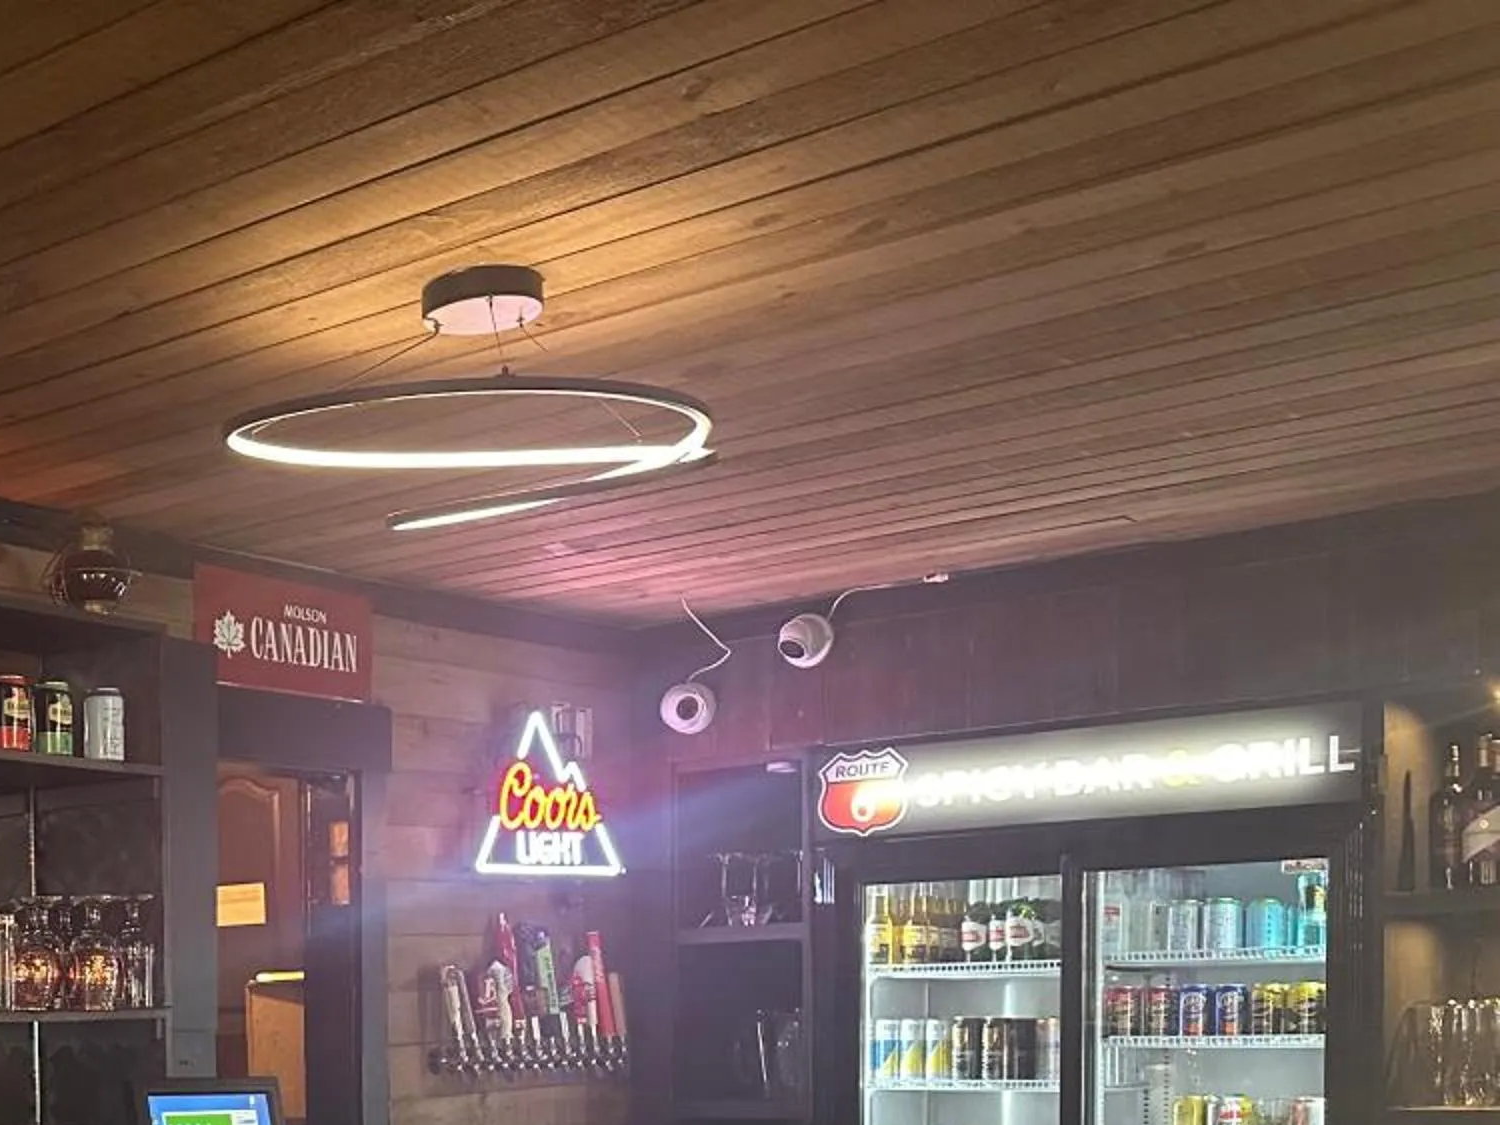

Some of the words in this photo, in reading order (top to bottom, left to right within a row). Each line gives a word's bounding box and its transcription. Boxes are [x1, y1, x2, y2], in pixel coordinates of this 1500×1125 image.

[283, 603, 327, 625] MOLSON
[251, 616, 357, 673] CANADIAN
[500, 761, 603, 833] Coors
[515, 830, 586, 866] LIGHT
